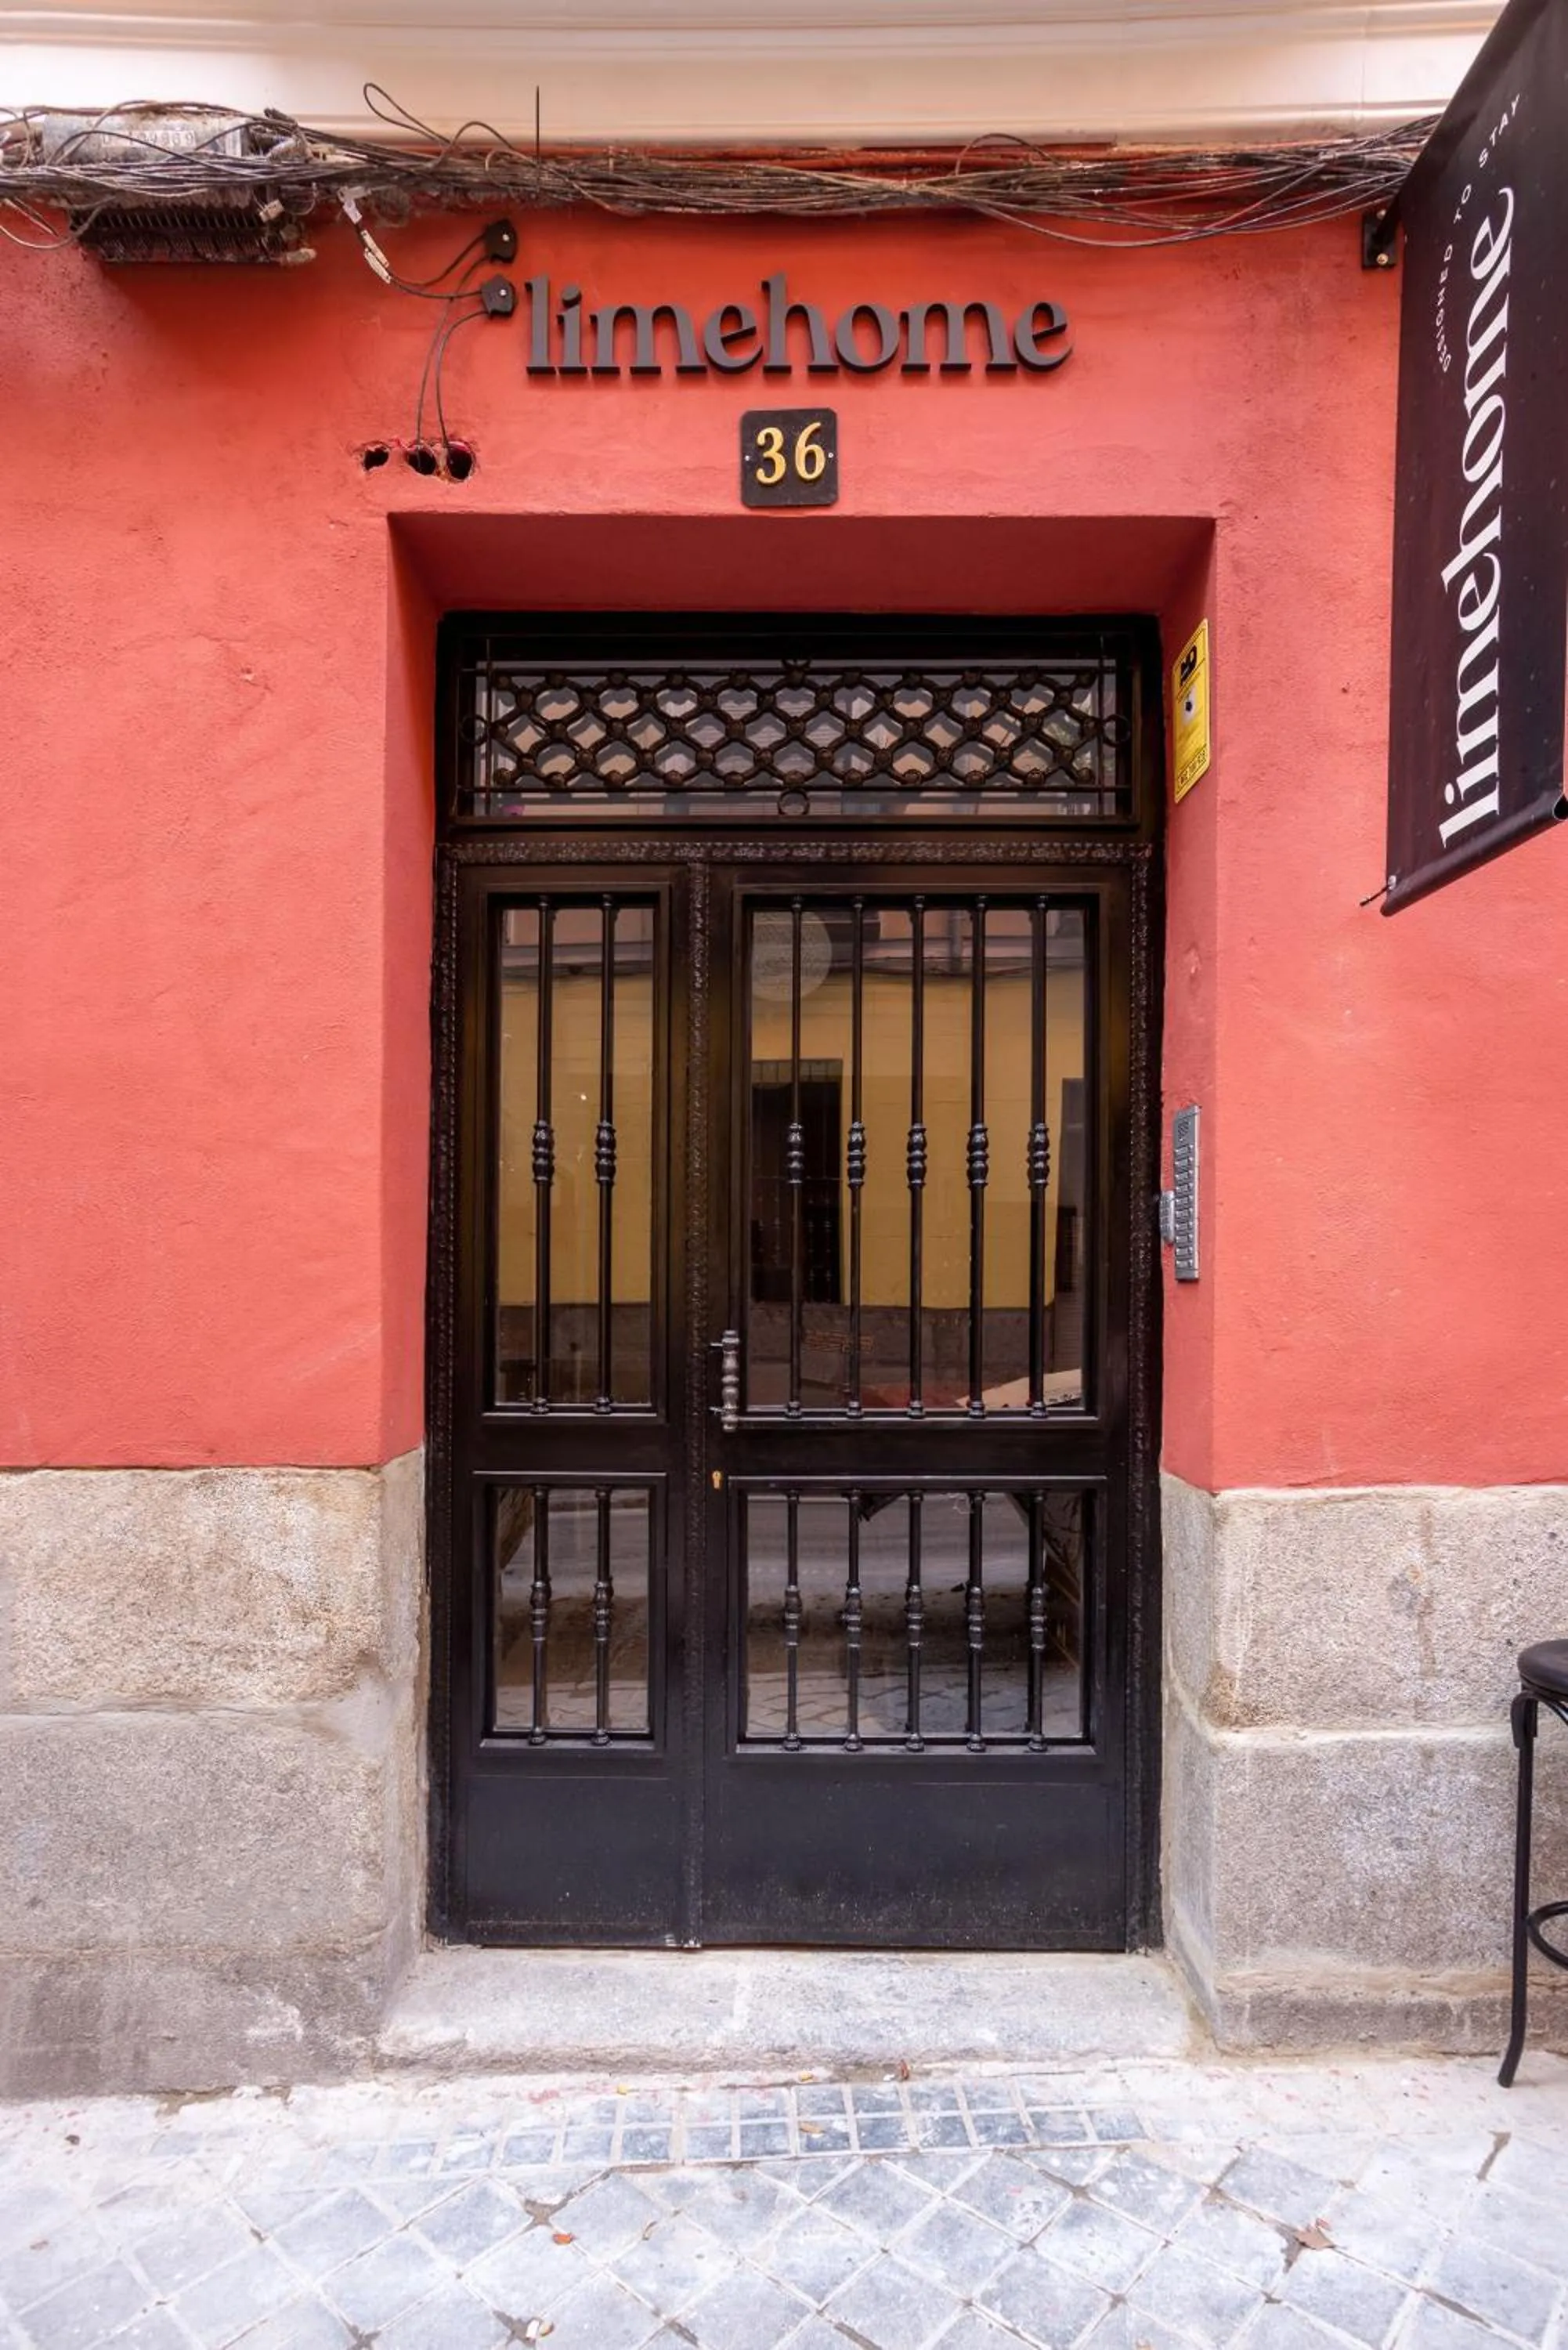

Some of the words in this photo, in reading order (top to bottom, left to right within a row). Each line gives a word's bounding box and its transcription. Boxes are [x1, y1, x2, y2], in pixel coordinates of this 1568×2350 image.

[525, 273, 1072, 375] limehome
[1436, 244, 1453, 373] DESIGNED
[1453, 184, 1472, 224] TO
[1479, 93, 1520, 168] STAY
[755, 422, 826, 485] 36
[1438, 187, 1514, 848] limehome
